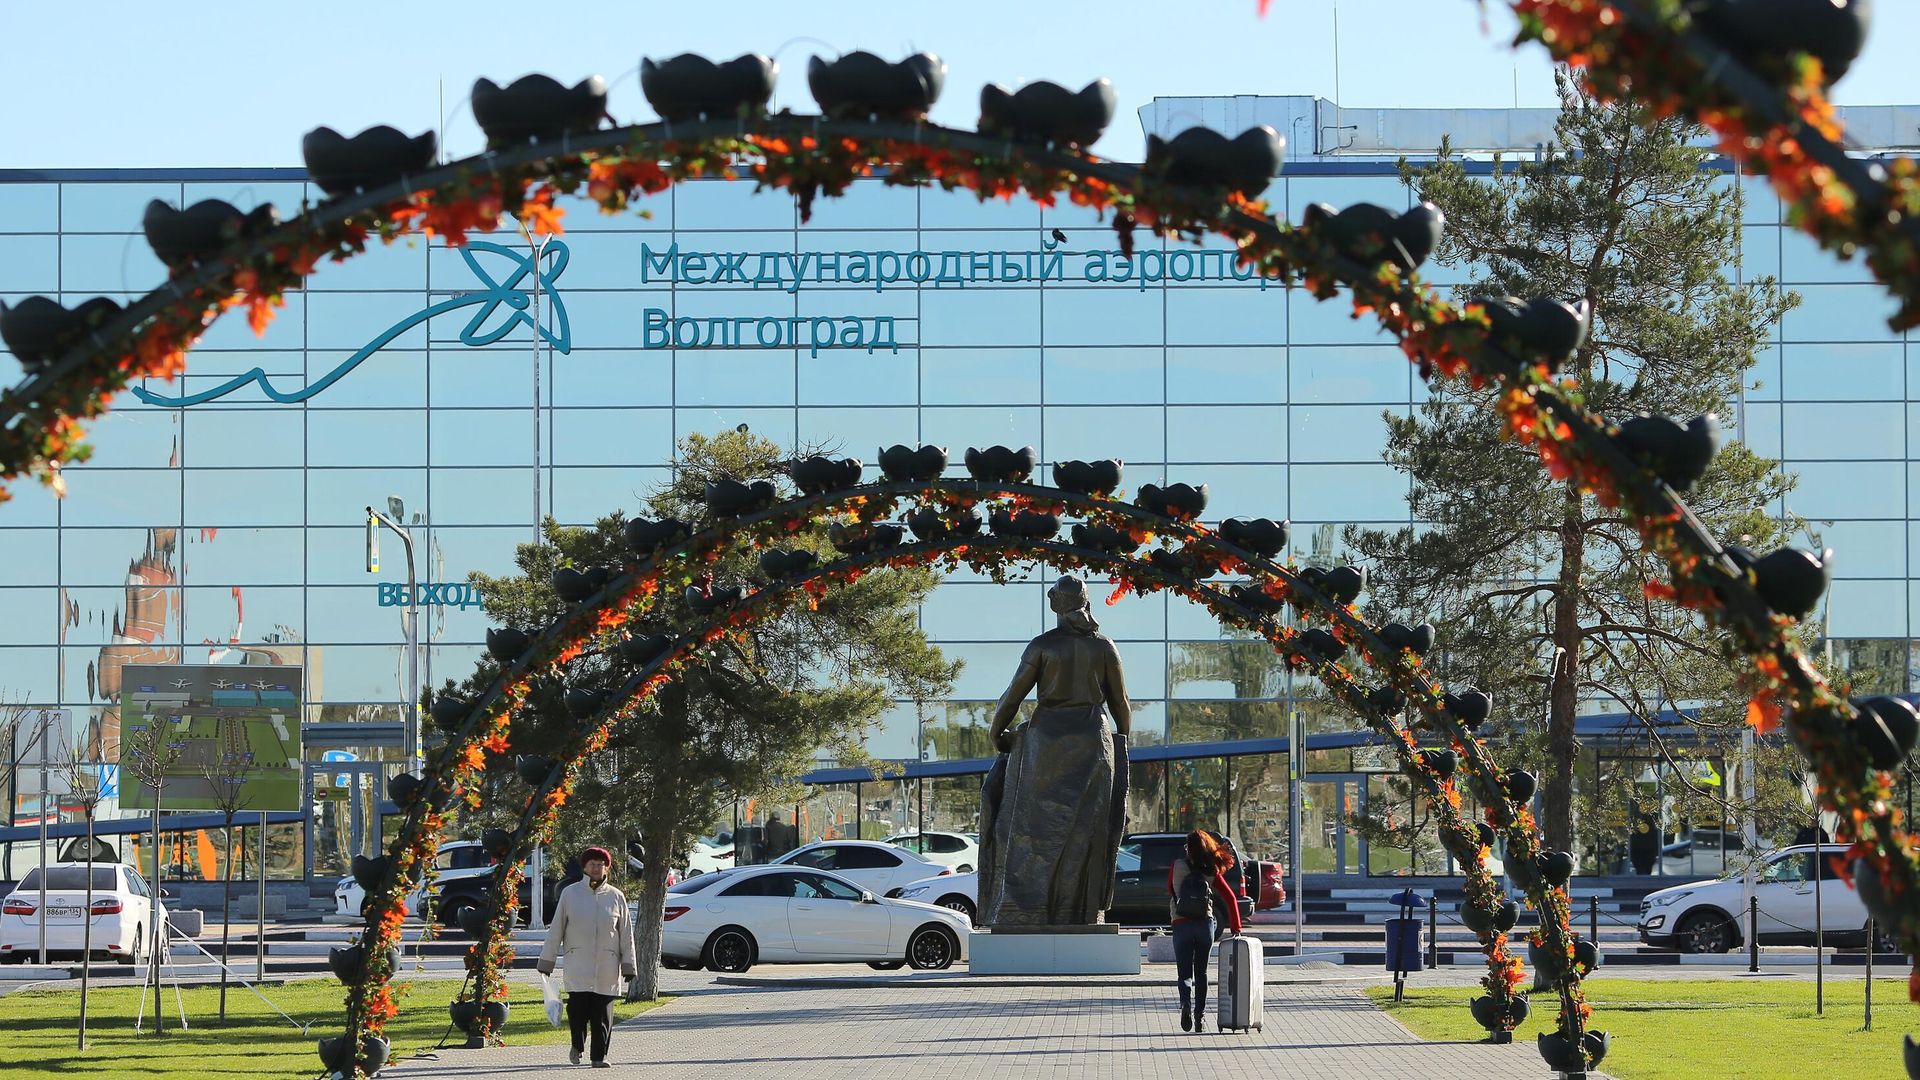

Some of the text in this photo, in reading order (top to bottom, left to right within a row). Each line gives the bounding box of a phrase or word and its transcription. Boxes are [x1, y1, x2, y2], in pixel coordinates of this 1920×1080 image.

[641, 240, 1303, 293] Международный аэропо
[643, 308, 897, 358] Волгоград
[44, 908, 68, 916] 886ВР
